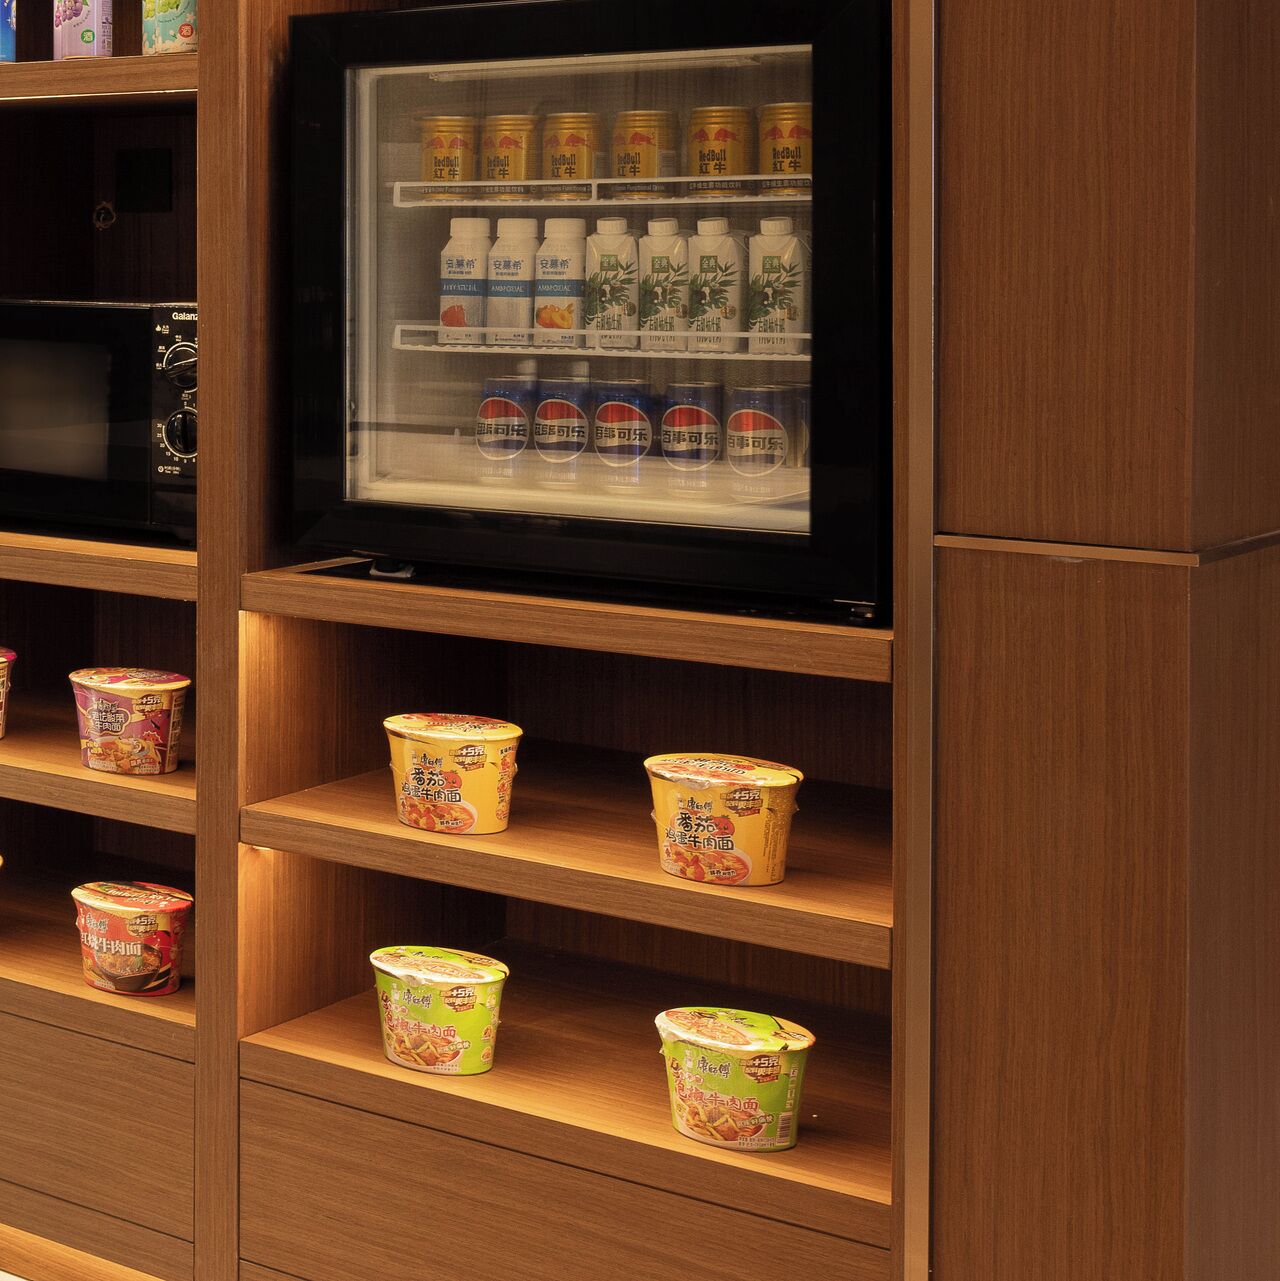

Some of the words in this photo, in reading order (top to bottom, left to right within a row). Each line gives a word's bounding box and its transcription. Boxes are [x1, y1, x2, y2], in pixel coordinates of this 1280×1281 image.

[699, 150, 726, 162] RedBull
[773, 147, 801, 160] RedBull
[699, 162, 726, 175] 红牛
[773, 160, 801, 172] 红牛
[433, 168, 459, 179] 红牛
[446, 258, 475, 270] 安慕希
[493, 259, 521, 271] 安慕希
[540, 258, 568, 270] 安慕希
[595, 426, 647, 441] 百事可乐
[663, 430, 718, 446] 百事可乐
[728, 434, 783, 450] 百事可乐
[410, 767, 446, 787] 番茄
[401, 782, 462, 803] 鸡蛋牛肉面
[676, 812, 717, 833] 番茄
[665, 828, 735, 851] 鸡蛋牛肉面
